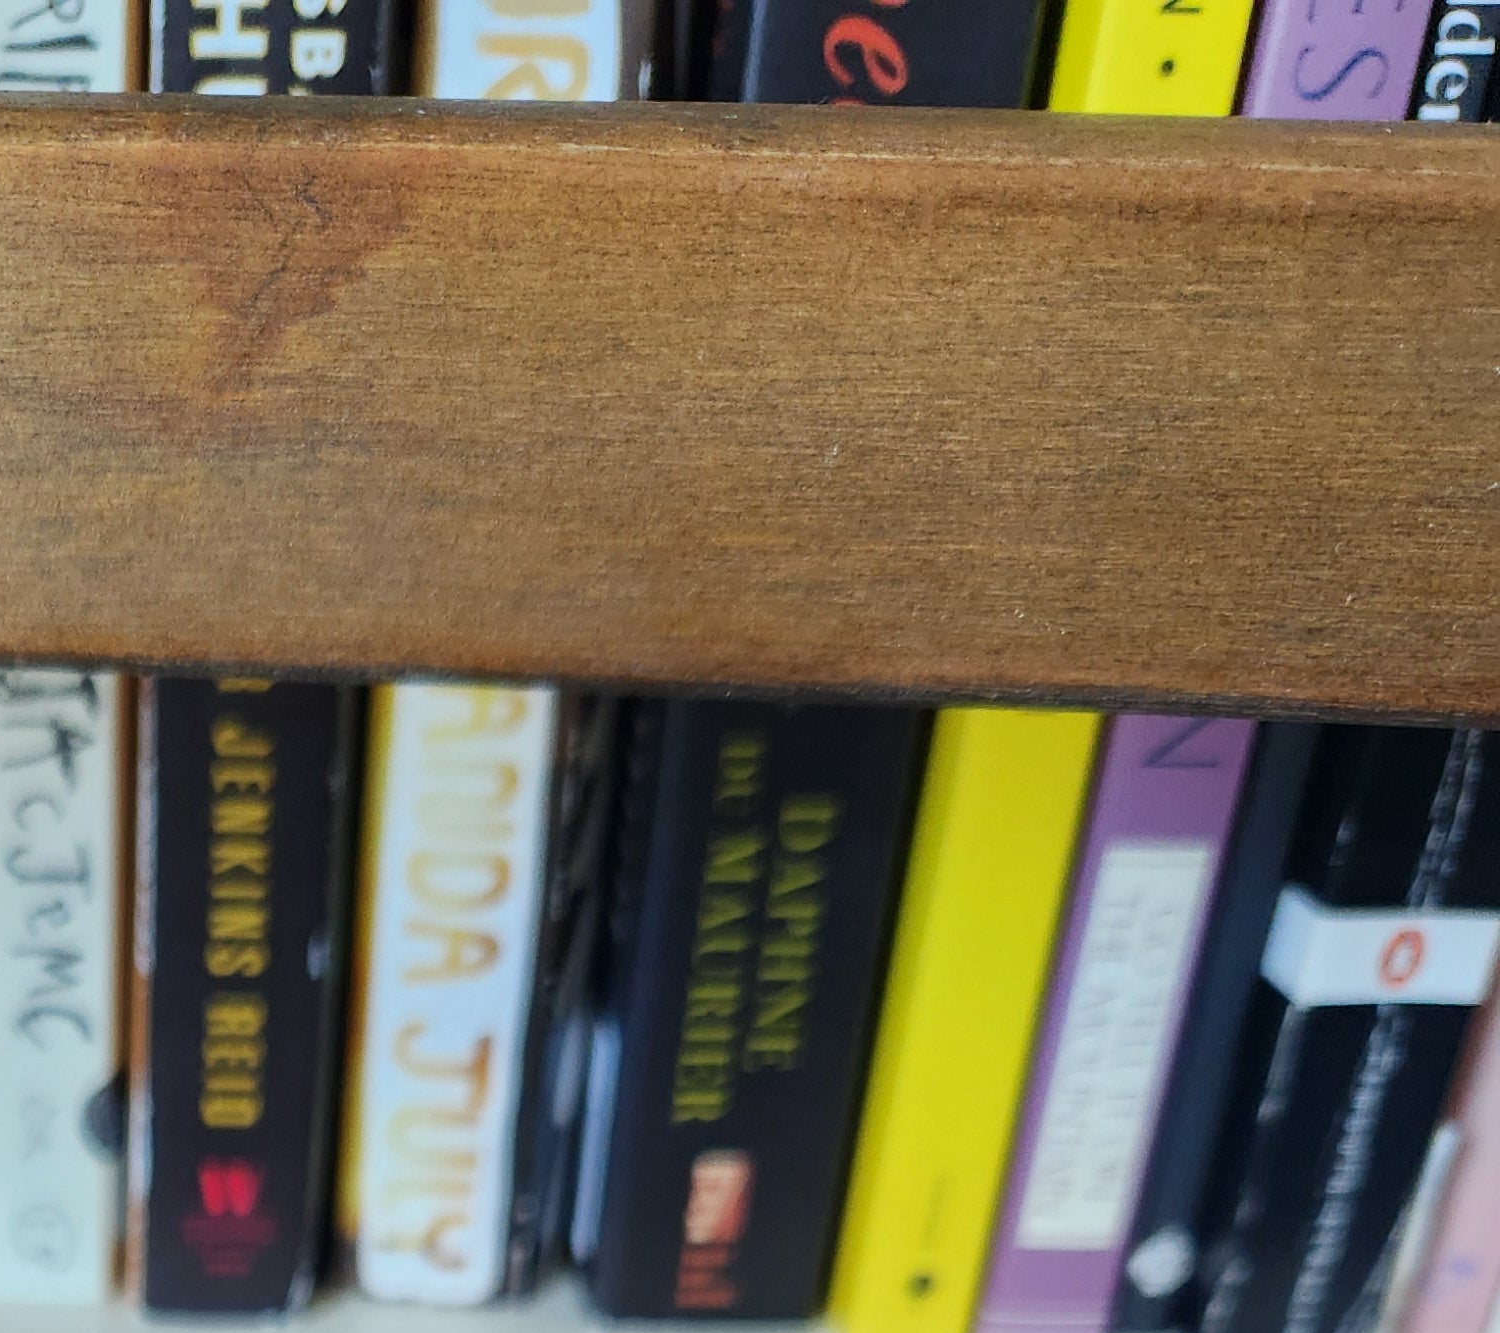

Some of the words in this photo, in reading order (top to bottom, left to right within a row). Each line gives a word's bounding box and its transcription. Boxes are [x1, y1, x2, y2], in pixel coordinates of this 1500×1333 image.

[203, 718, 277, 979] JENKINS
[744, 792, 842, 1074] DAPHNE
[200, 993, 270, 1130] REID
[375, 1018, 494, 1275] JULY
